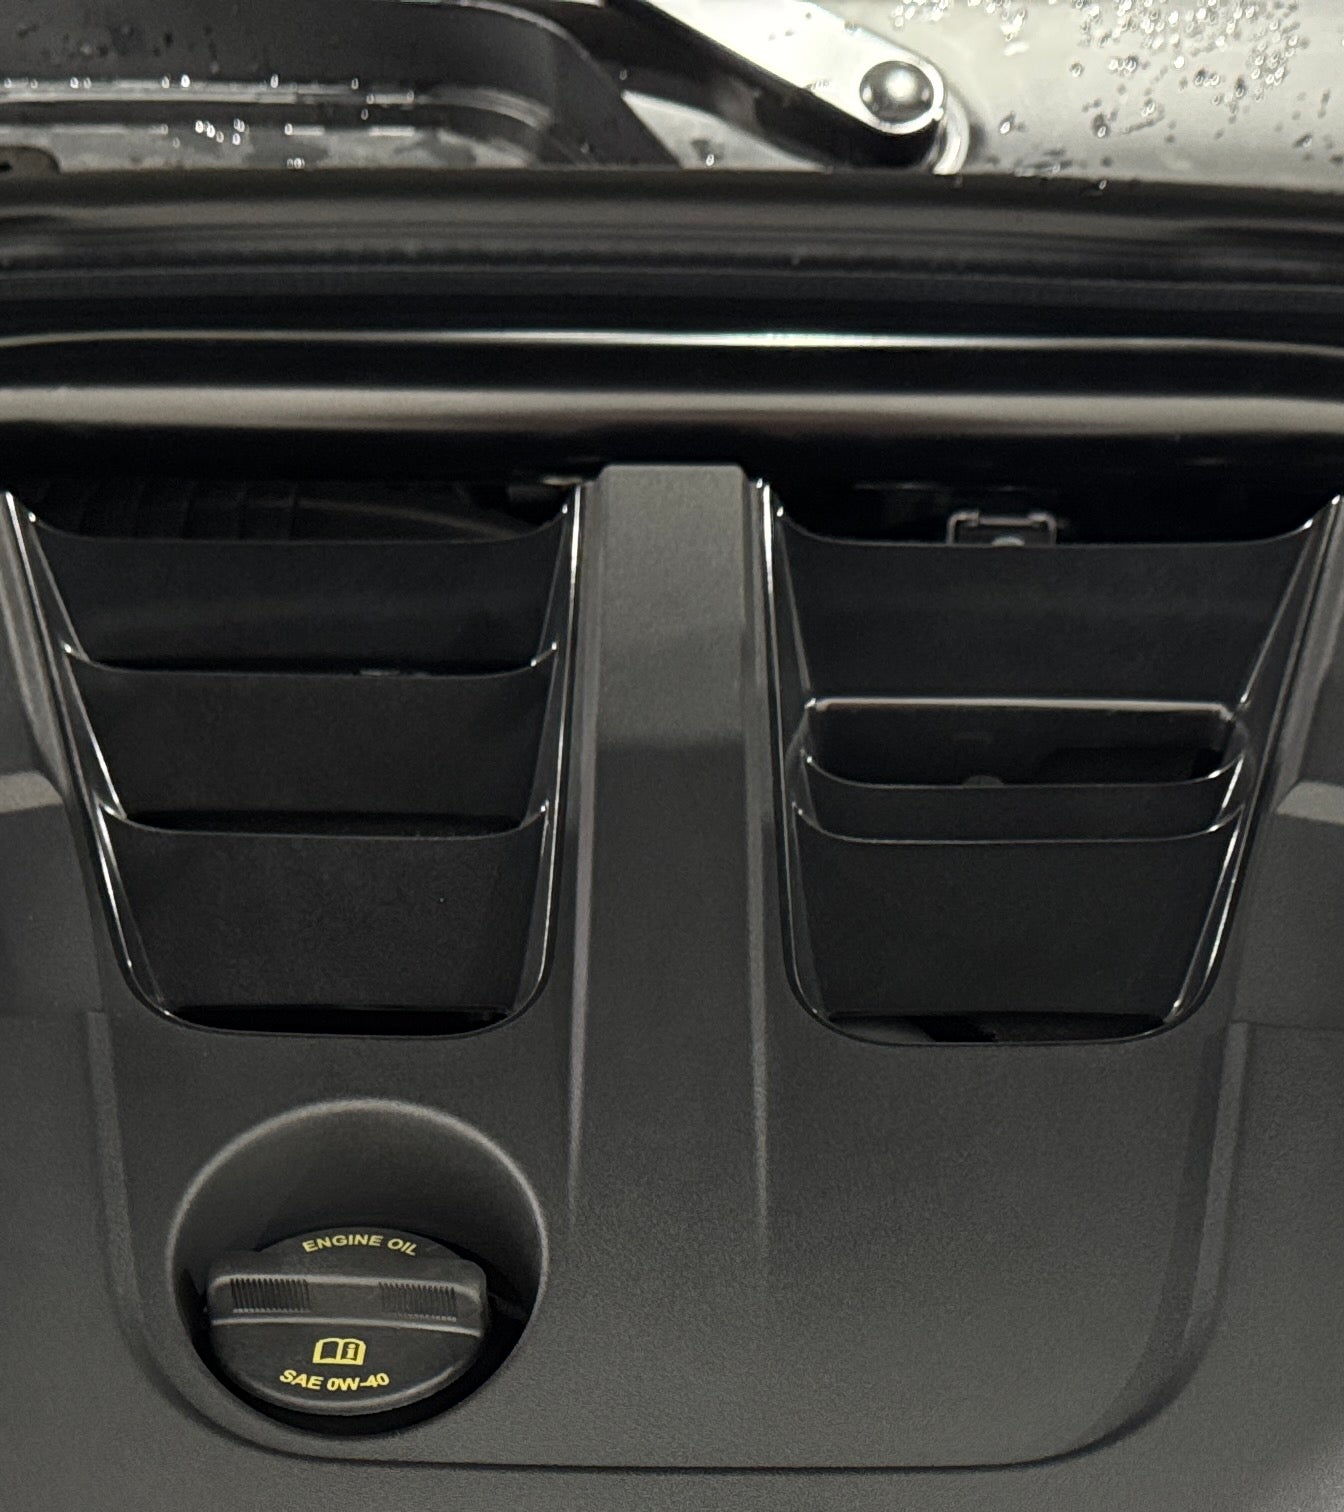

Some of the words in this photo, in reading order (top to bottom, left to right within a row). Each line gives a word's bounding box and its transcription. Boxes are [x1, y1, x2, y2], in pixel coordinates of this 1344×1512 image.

[302, 1234, 383, 1253] ENGINE
[387, 1237, 417, 1256] OIL
[279, 1369, 323, 1391] SAE
[326, 1372, 391, 1392] 0W-40
